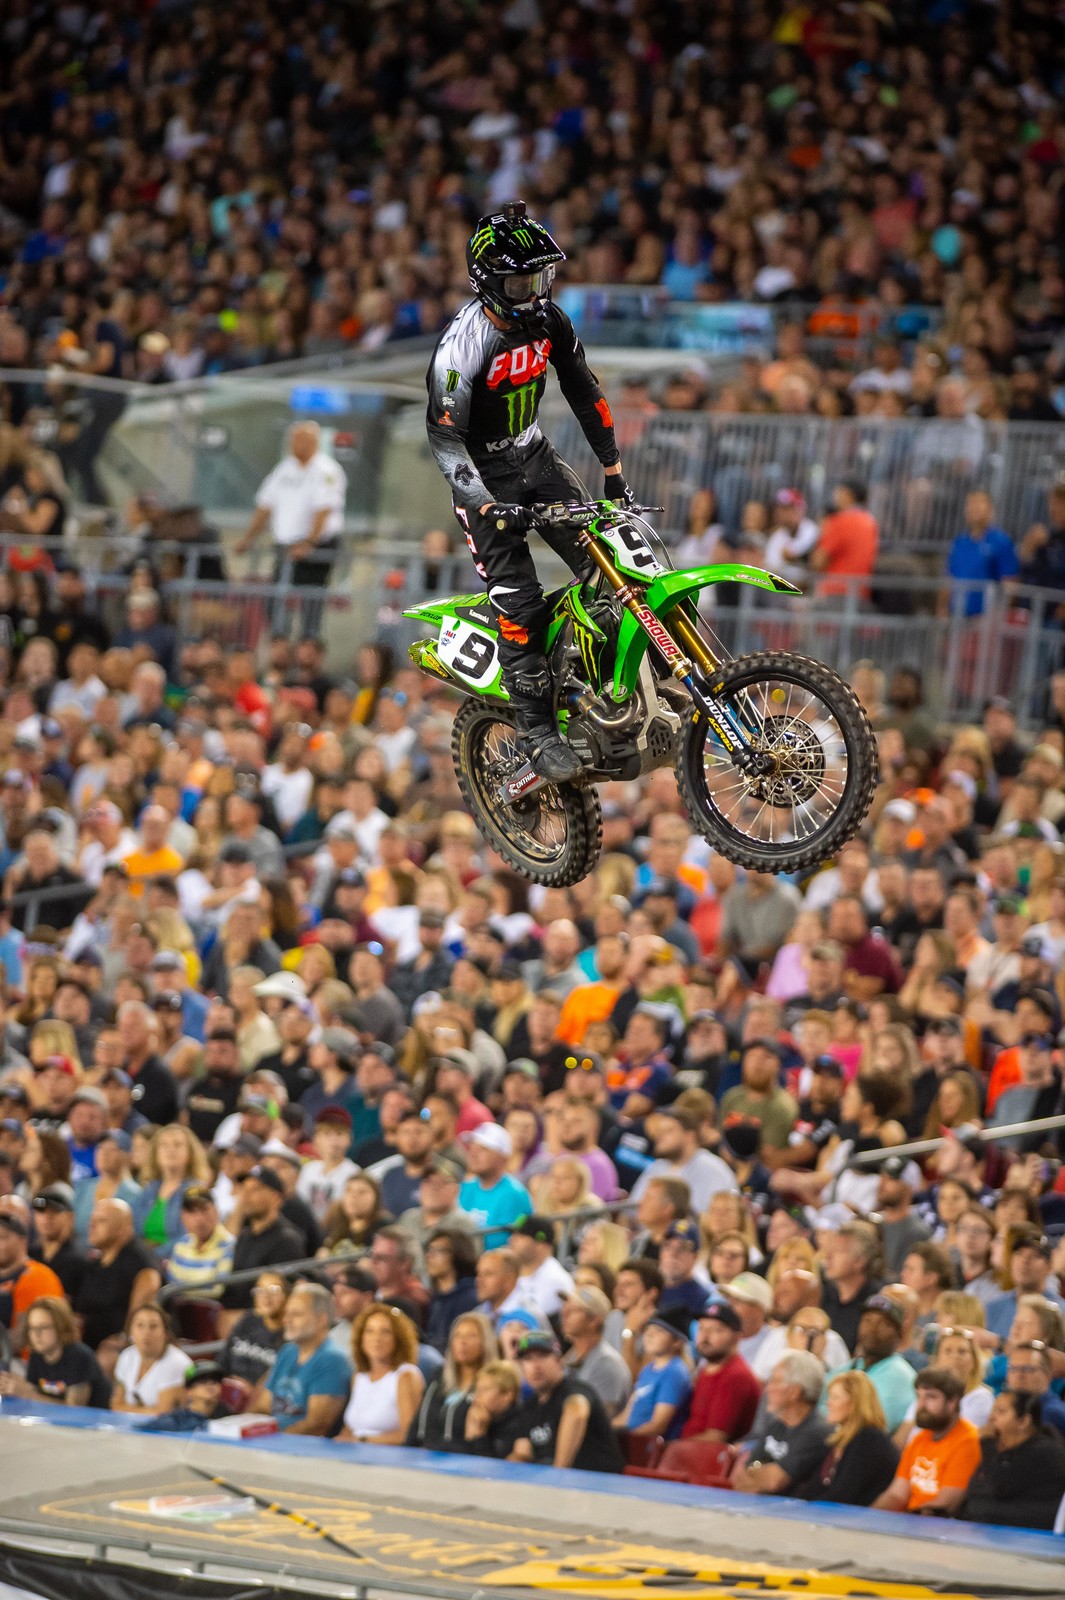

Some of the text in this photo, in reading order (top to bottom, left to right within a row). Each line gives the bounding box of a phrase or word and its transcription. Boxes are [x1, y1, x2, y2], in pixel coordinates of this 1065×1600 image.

[472, 264, 488, 281] FOX
[486, 338, 552, 389] FOX
[618, 525, 655, 568] 9
[420, 611, 442, 620] DUNLOP
[636, 609, 679, 658] SHOWA
[452, 632, 495, 680] 9
[703, 696, 744, 750] DUNLOP
